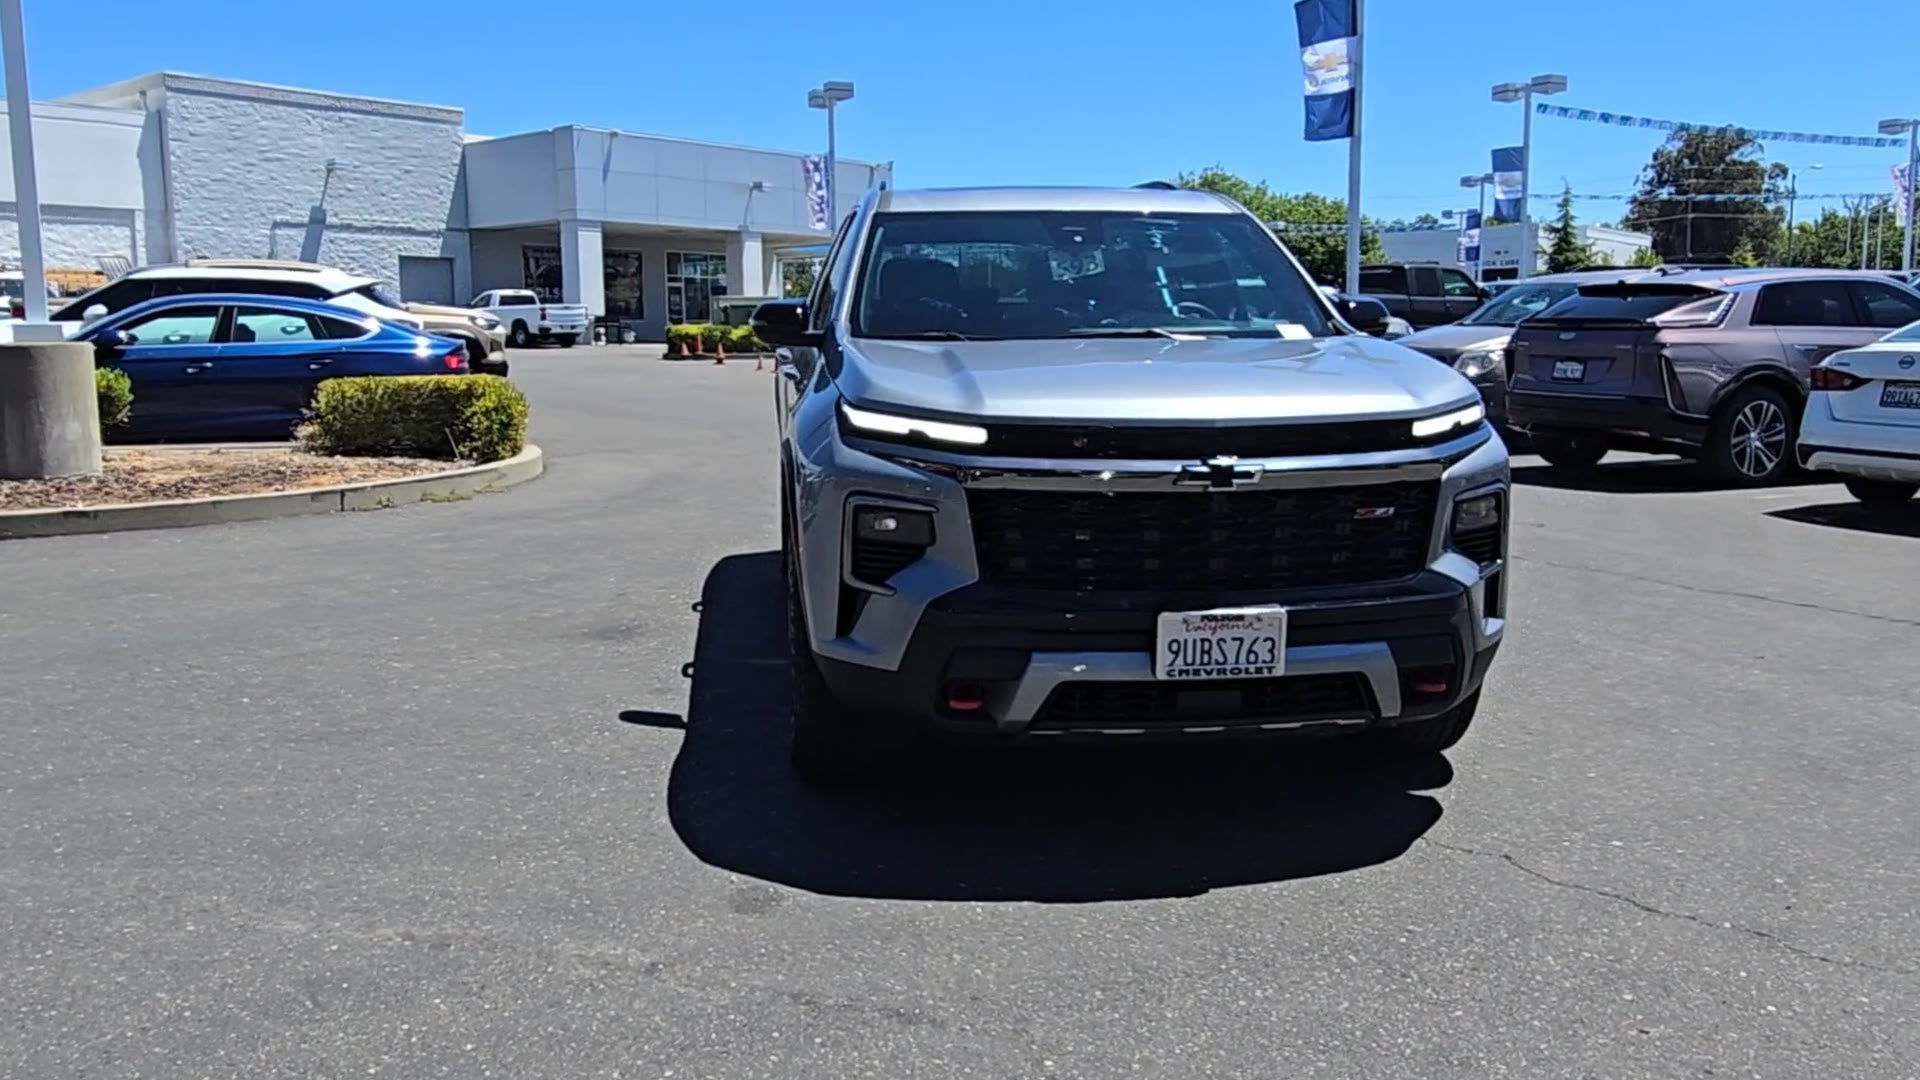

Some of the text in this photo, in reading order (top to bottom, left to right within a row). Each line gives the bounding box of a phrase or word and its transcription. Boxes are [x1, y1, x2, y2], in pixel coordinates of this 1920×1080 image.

[1353, 507, 1395, 519] Z71
[1183, 619, 1262, 636] California
[1167, 637, 1276, 667] 9UBS763
[1166, 666, 1276, 677] CHEVROLET
